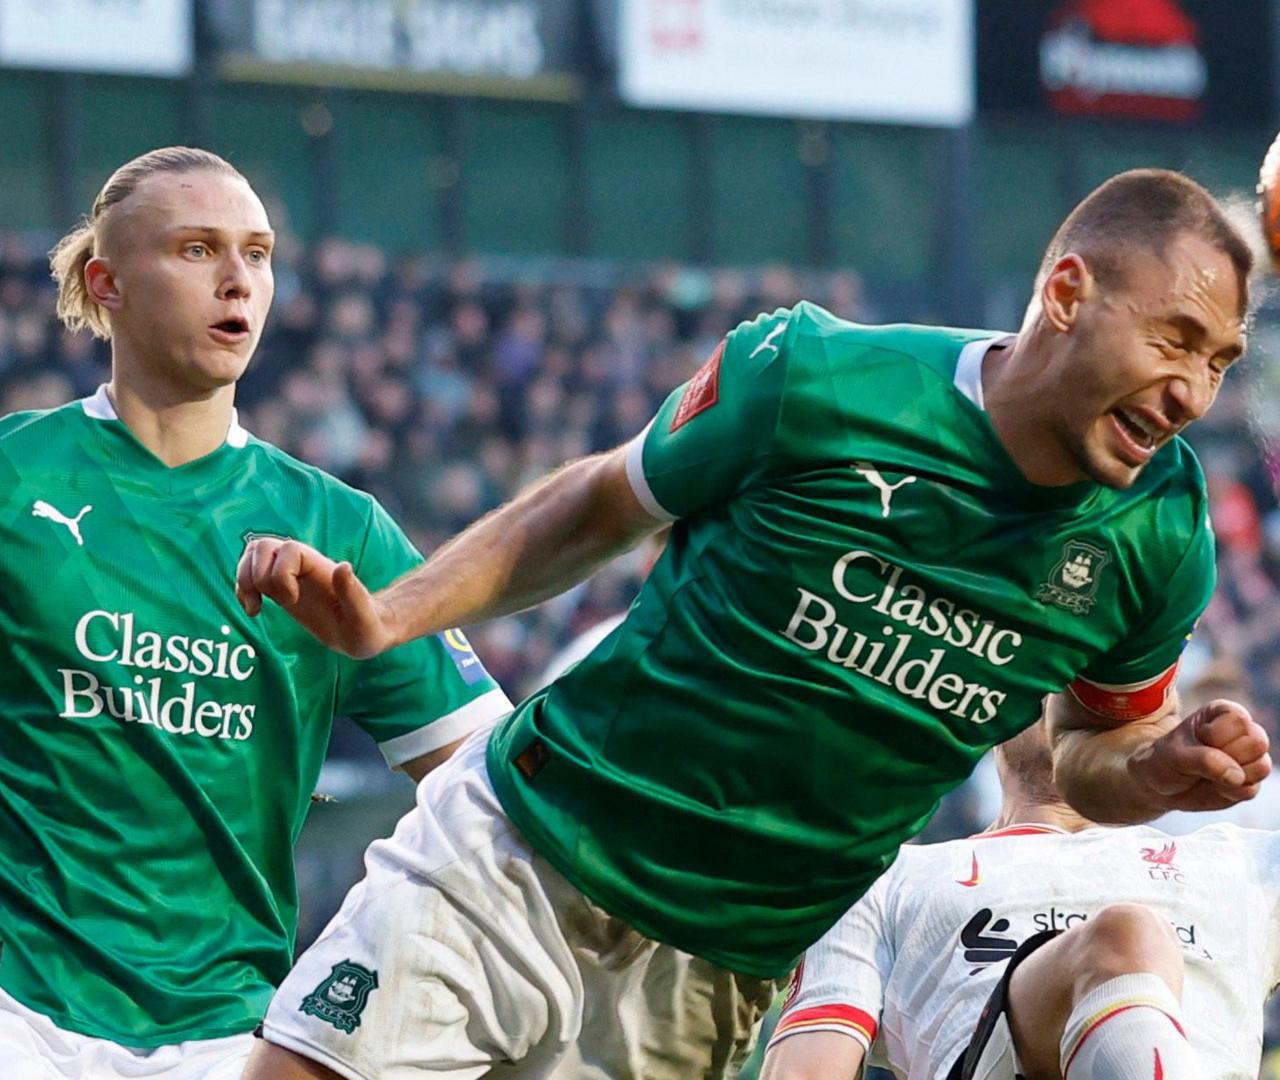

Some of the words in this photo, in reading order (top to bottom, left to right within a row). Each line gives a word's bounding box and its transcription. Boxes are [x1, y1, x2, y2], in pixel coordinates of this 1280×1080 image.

[74, 610, 256, 681] Classic
[831, 550, 1023, 666] Classic
[778, 587, 1007, 724] Builders
[57, 668, 256, 741] Builders
